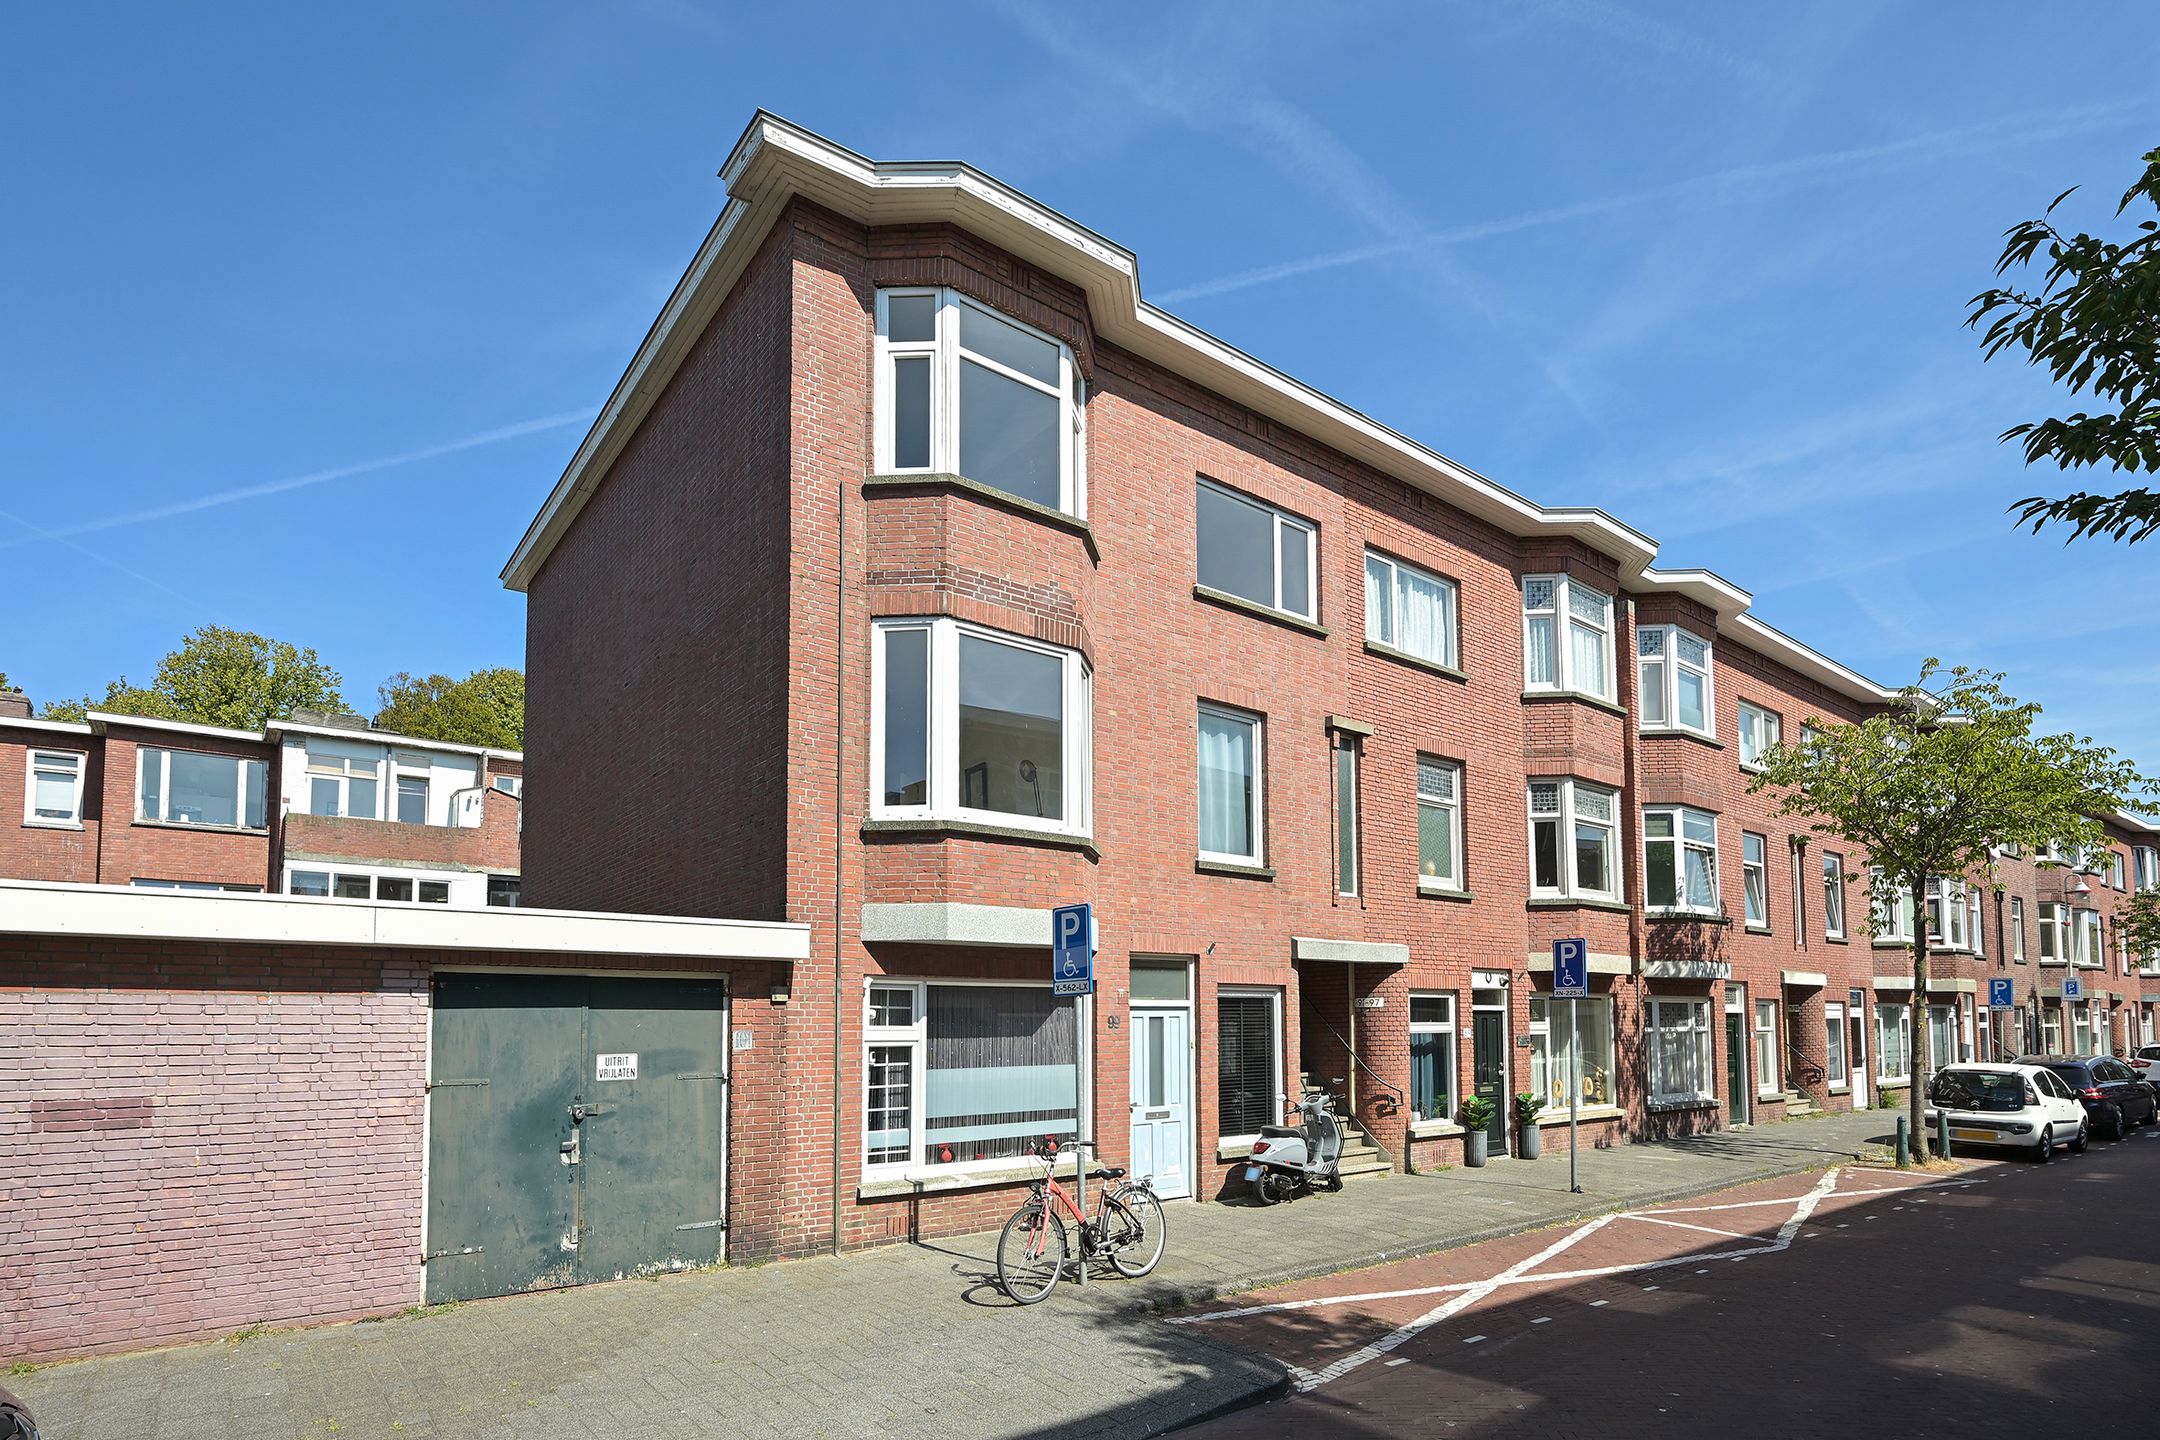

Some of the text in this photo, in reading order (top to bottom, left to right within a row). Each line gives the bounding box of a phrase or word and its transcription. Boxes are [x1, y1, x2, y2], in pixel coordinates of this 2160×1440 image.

[1061, 911, 1080, 950] P
[1560, 943, 1577, 968] P
[1055, 983, 1088, 992] X-562-LX
[1994, 981, 2007, 995] P
[1107, 1015, 1120, 1029] 99
[604, 1056, 629, 1066] UITRIT
[598, 1068, 636, 1078] VRIJLATEN
